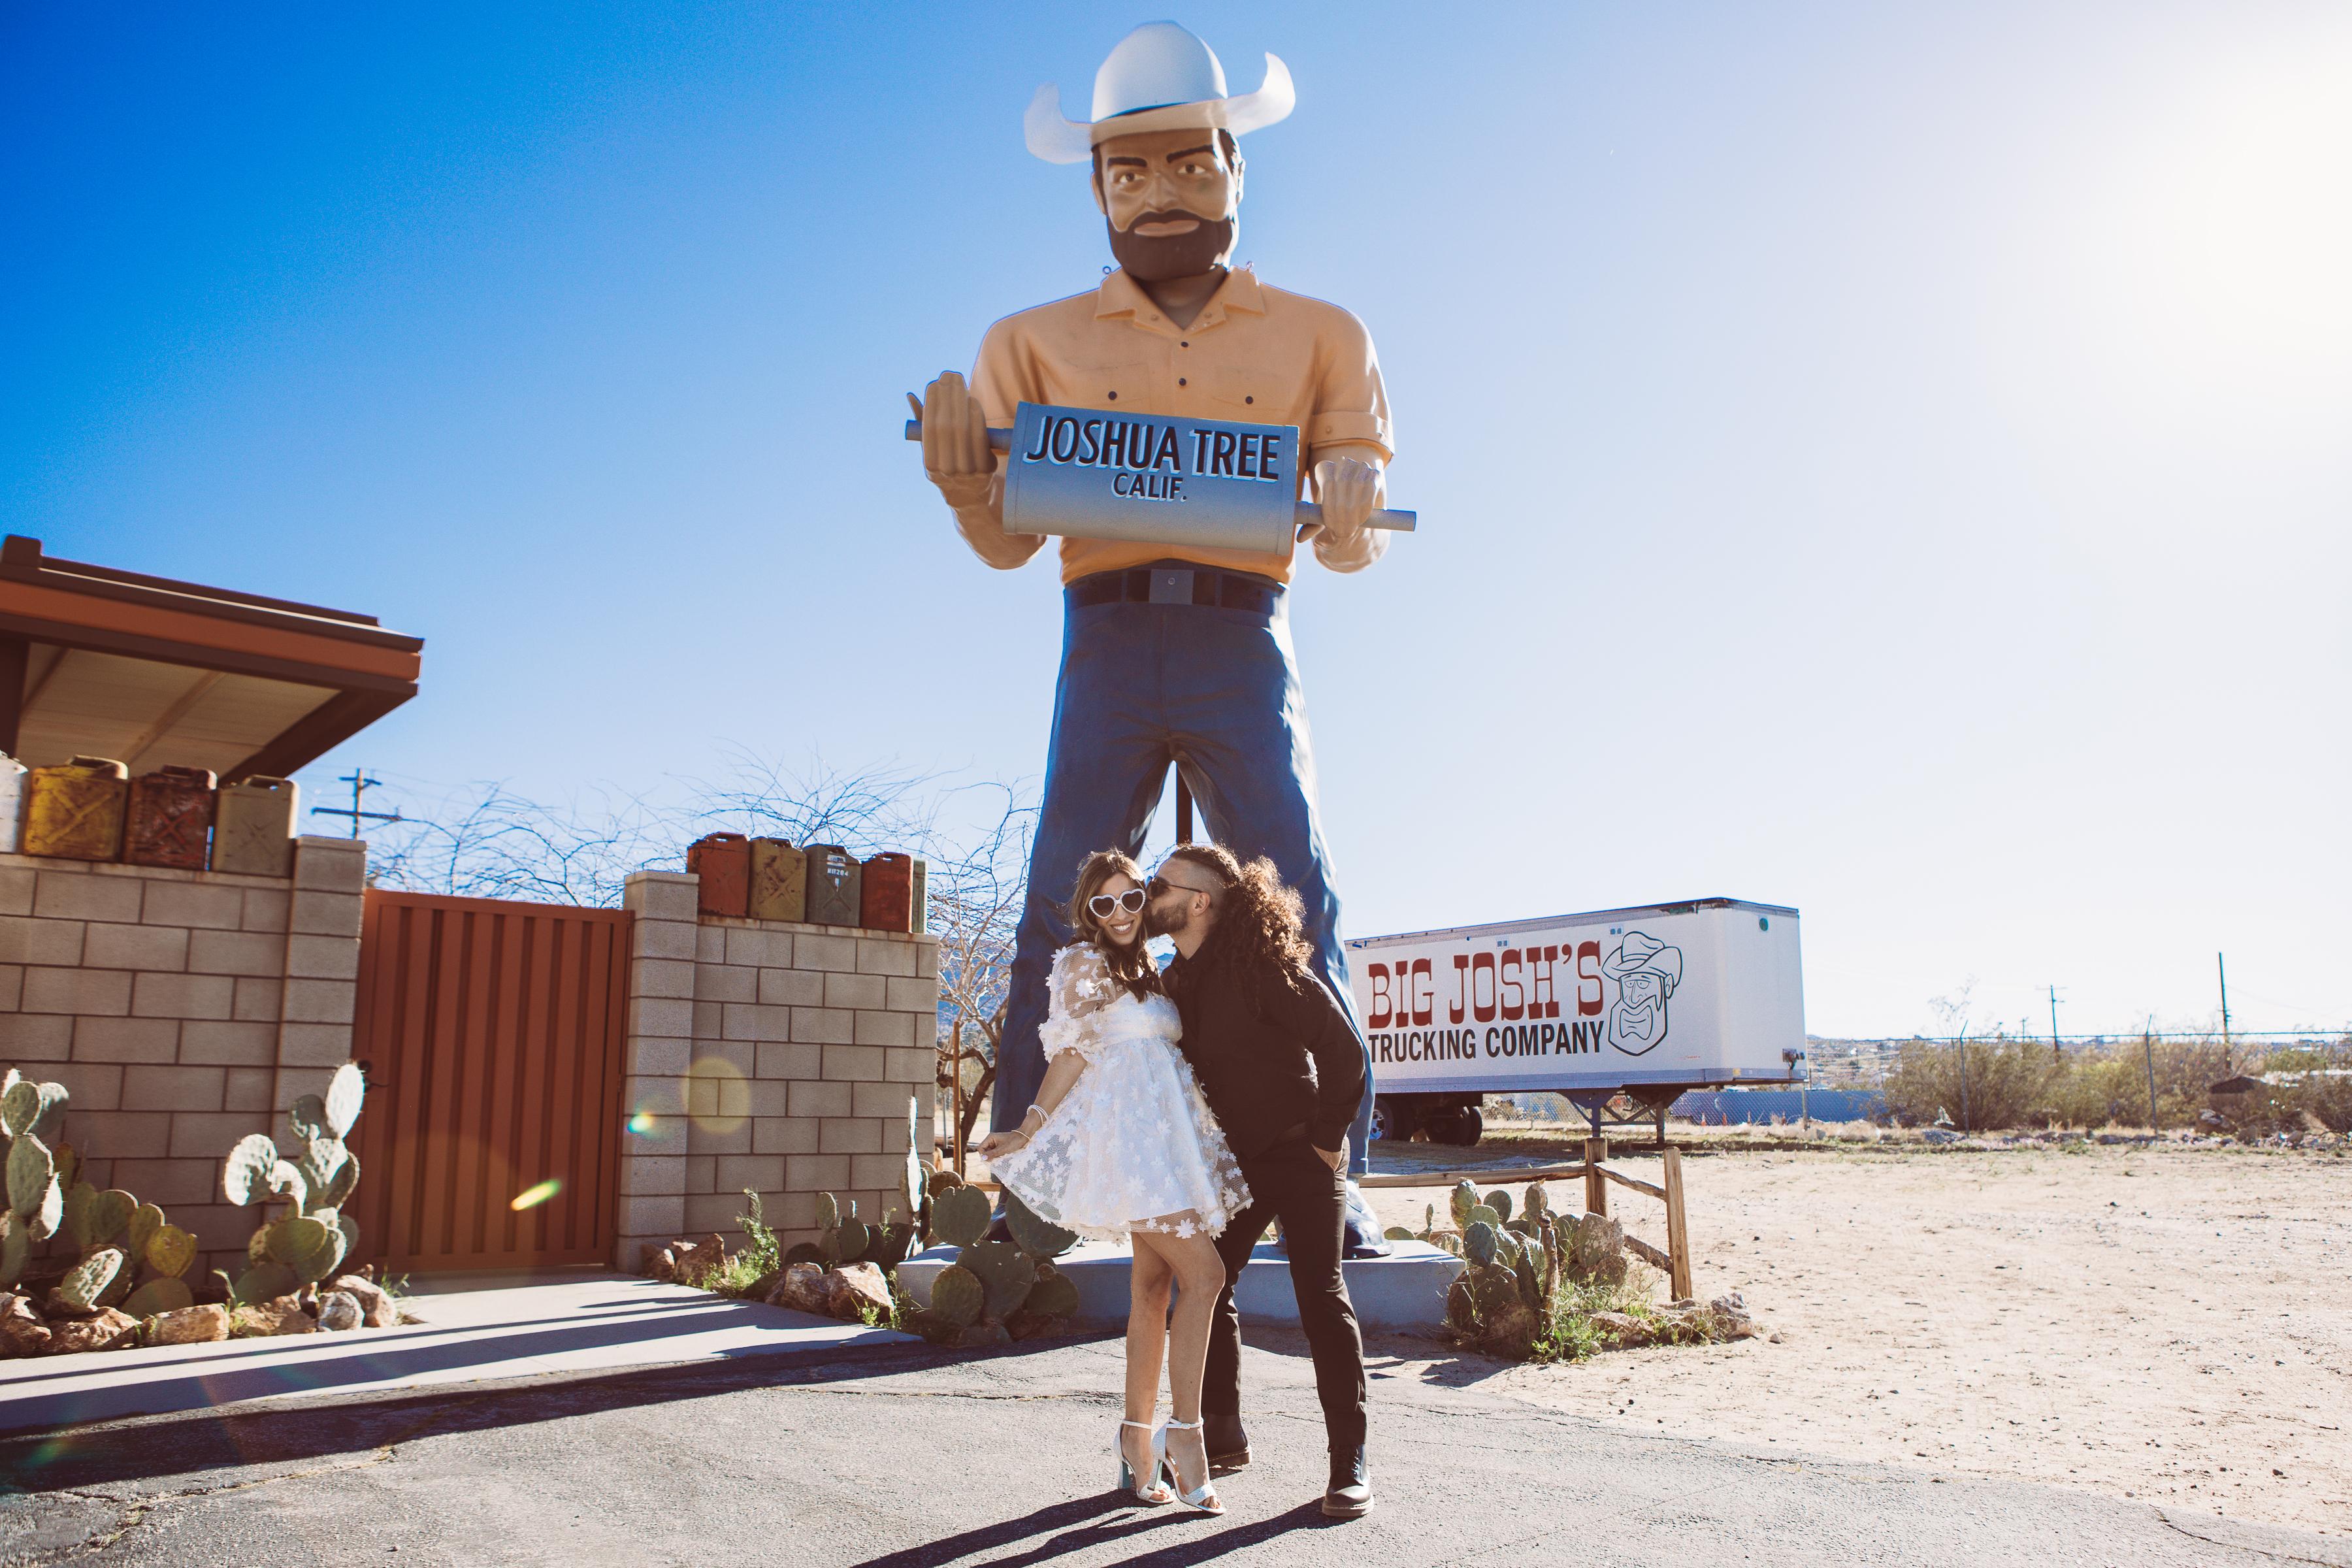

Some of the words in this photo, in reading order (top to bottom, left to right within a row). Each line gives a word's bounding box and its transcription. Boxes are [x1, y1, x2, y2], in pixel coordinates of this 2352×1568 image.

[1023, 416, 1181, 474] JOSHUA
[1189, 429, 1281, 483] TREE
[1112, 472, 1187, 502] CALIF.
[1369, 958, 1434, 1029] BIG
[1450, 940, 1604, 1024] JOSH'S
[1369, 1028, 1476, 1063] TRUCKING
[1486, 1021, 1604, 1058] COMPANY
